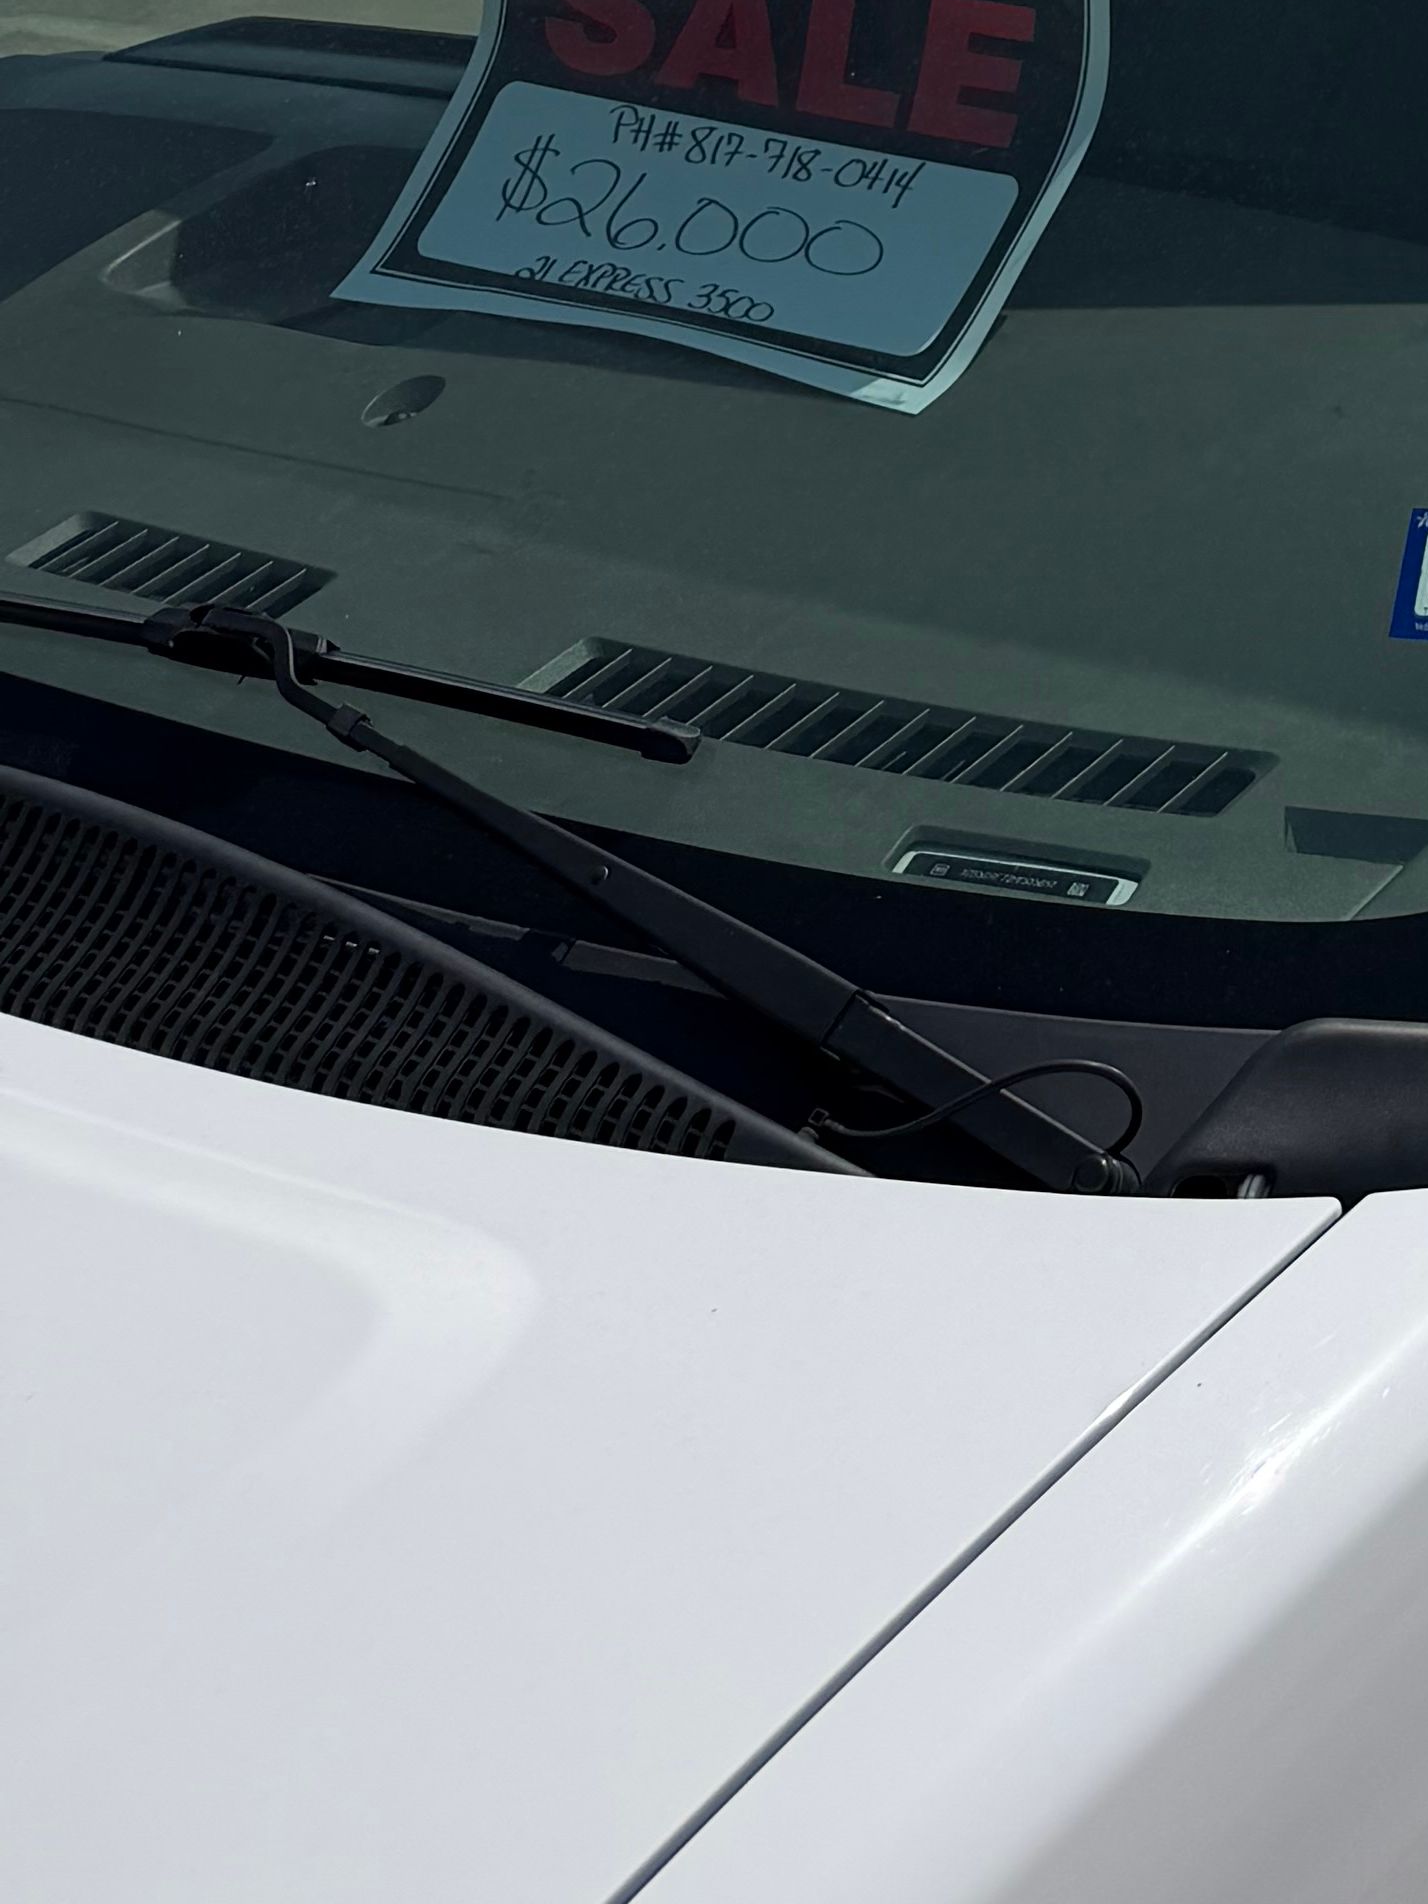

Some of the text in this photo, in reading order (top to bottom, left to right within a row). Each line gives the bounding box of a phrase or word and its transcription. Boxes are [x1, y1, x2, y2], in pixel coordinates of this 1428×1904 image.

[514, 255, 775, 323] 21 EXPRESS 3500
